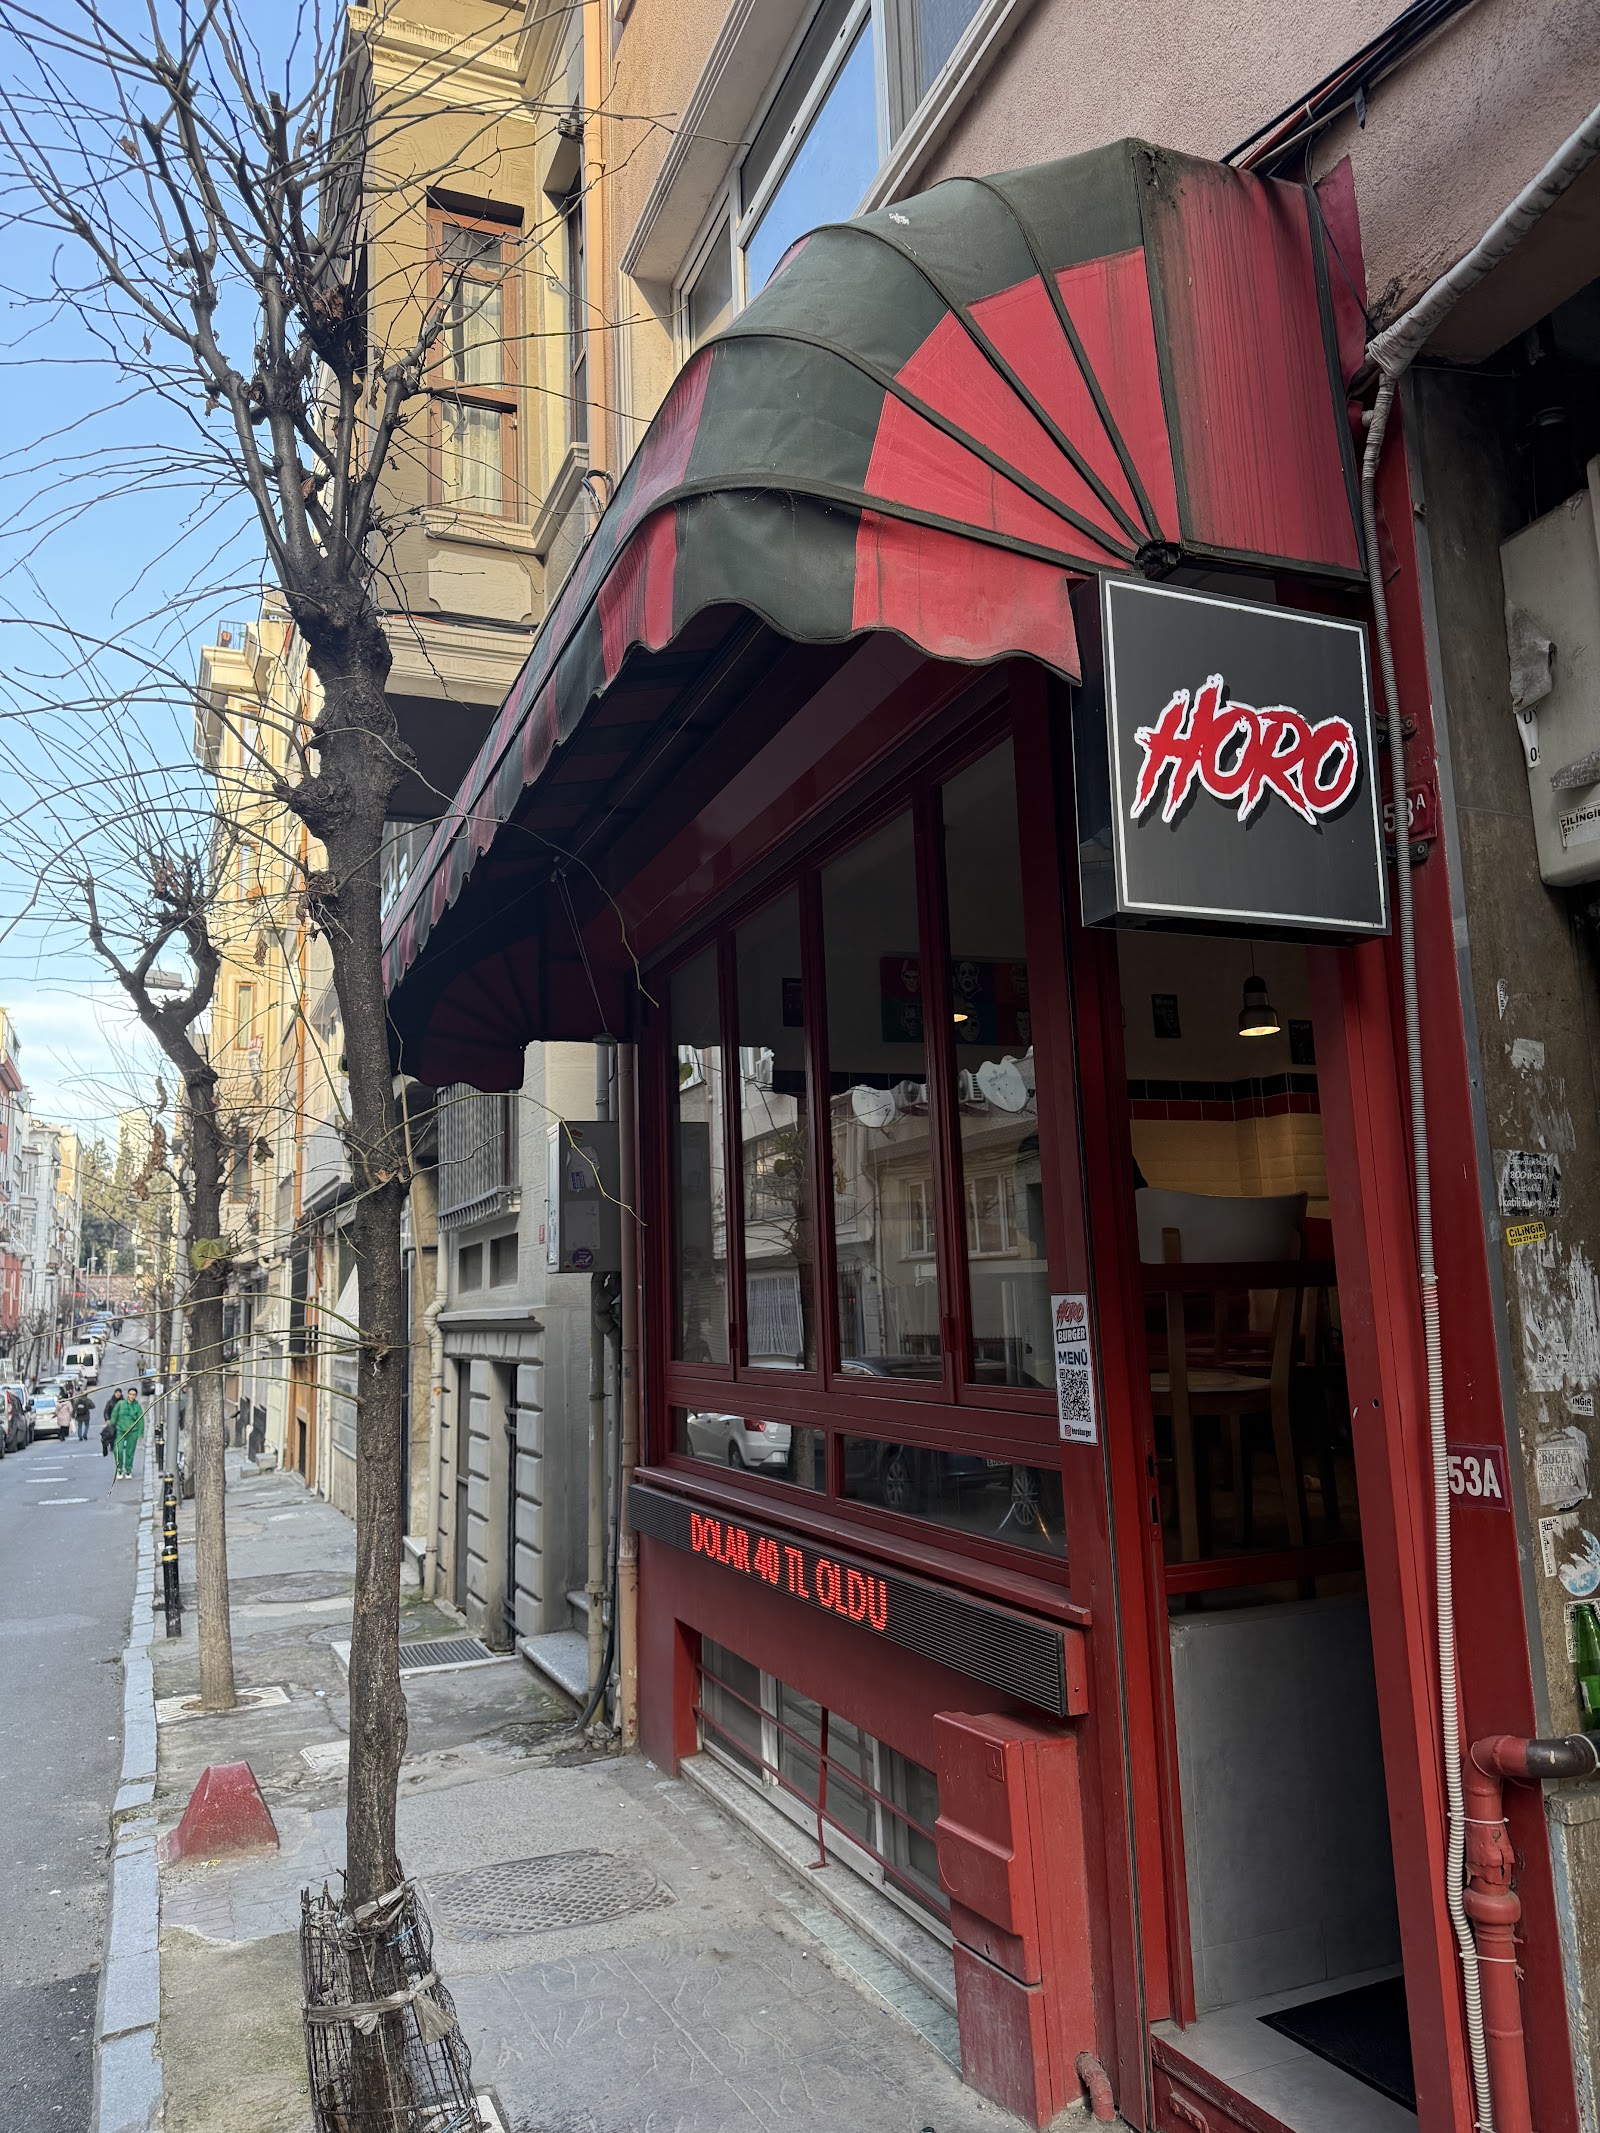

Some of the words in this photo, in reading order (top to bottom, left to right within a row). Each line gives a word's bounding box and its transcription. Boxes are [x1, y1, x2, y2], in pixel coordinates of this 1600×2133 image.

[1131, 673, 1358, 826] HORO
[1056, 1299, 1084, 1328] HORO
[1057, 1327, 1086, 1342] BURGER
[1058, 1349, 1088, 1365] MENÜ
[1447, 1455, 1502, 1498] 53A
[691, 1513, 750, 1573] DOLAR
[754, 1537, 780, 1585] 40
[784, 1546, 809, 1598] TL
[816, 1559, 887, 1631] OLDU
